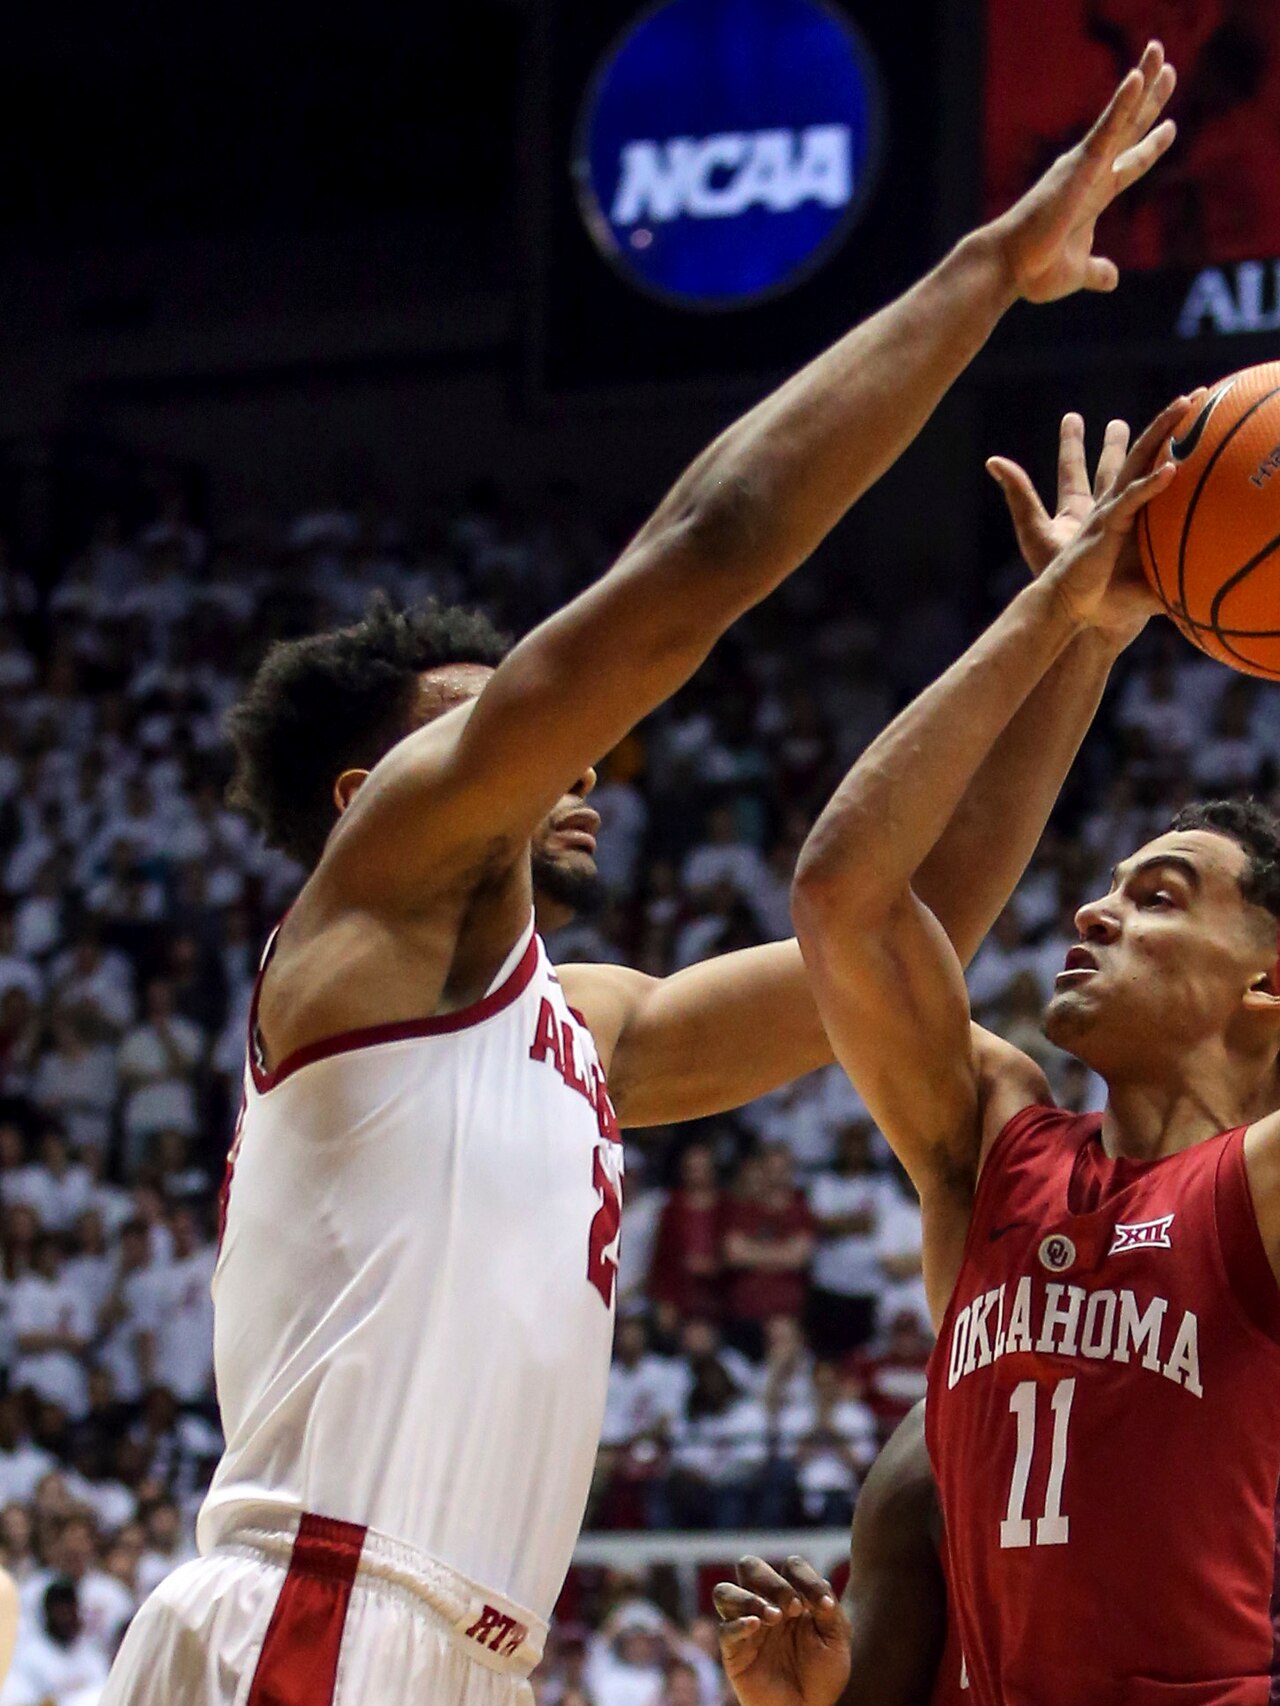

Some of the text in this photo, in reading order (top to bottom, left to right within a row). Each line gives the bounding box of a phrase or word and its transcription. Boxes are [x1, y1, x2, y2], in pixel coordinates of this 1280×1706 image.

[612, 124, 851, 226] NCAA
[947, 1276, 1204, 1399] OKLAHOMA
[1000, 1378, 1076, 1549] 11
